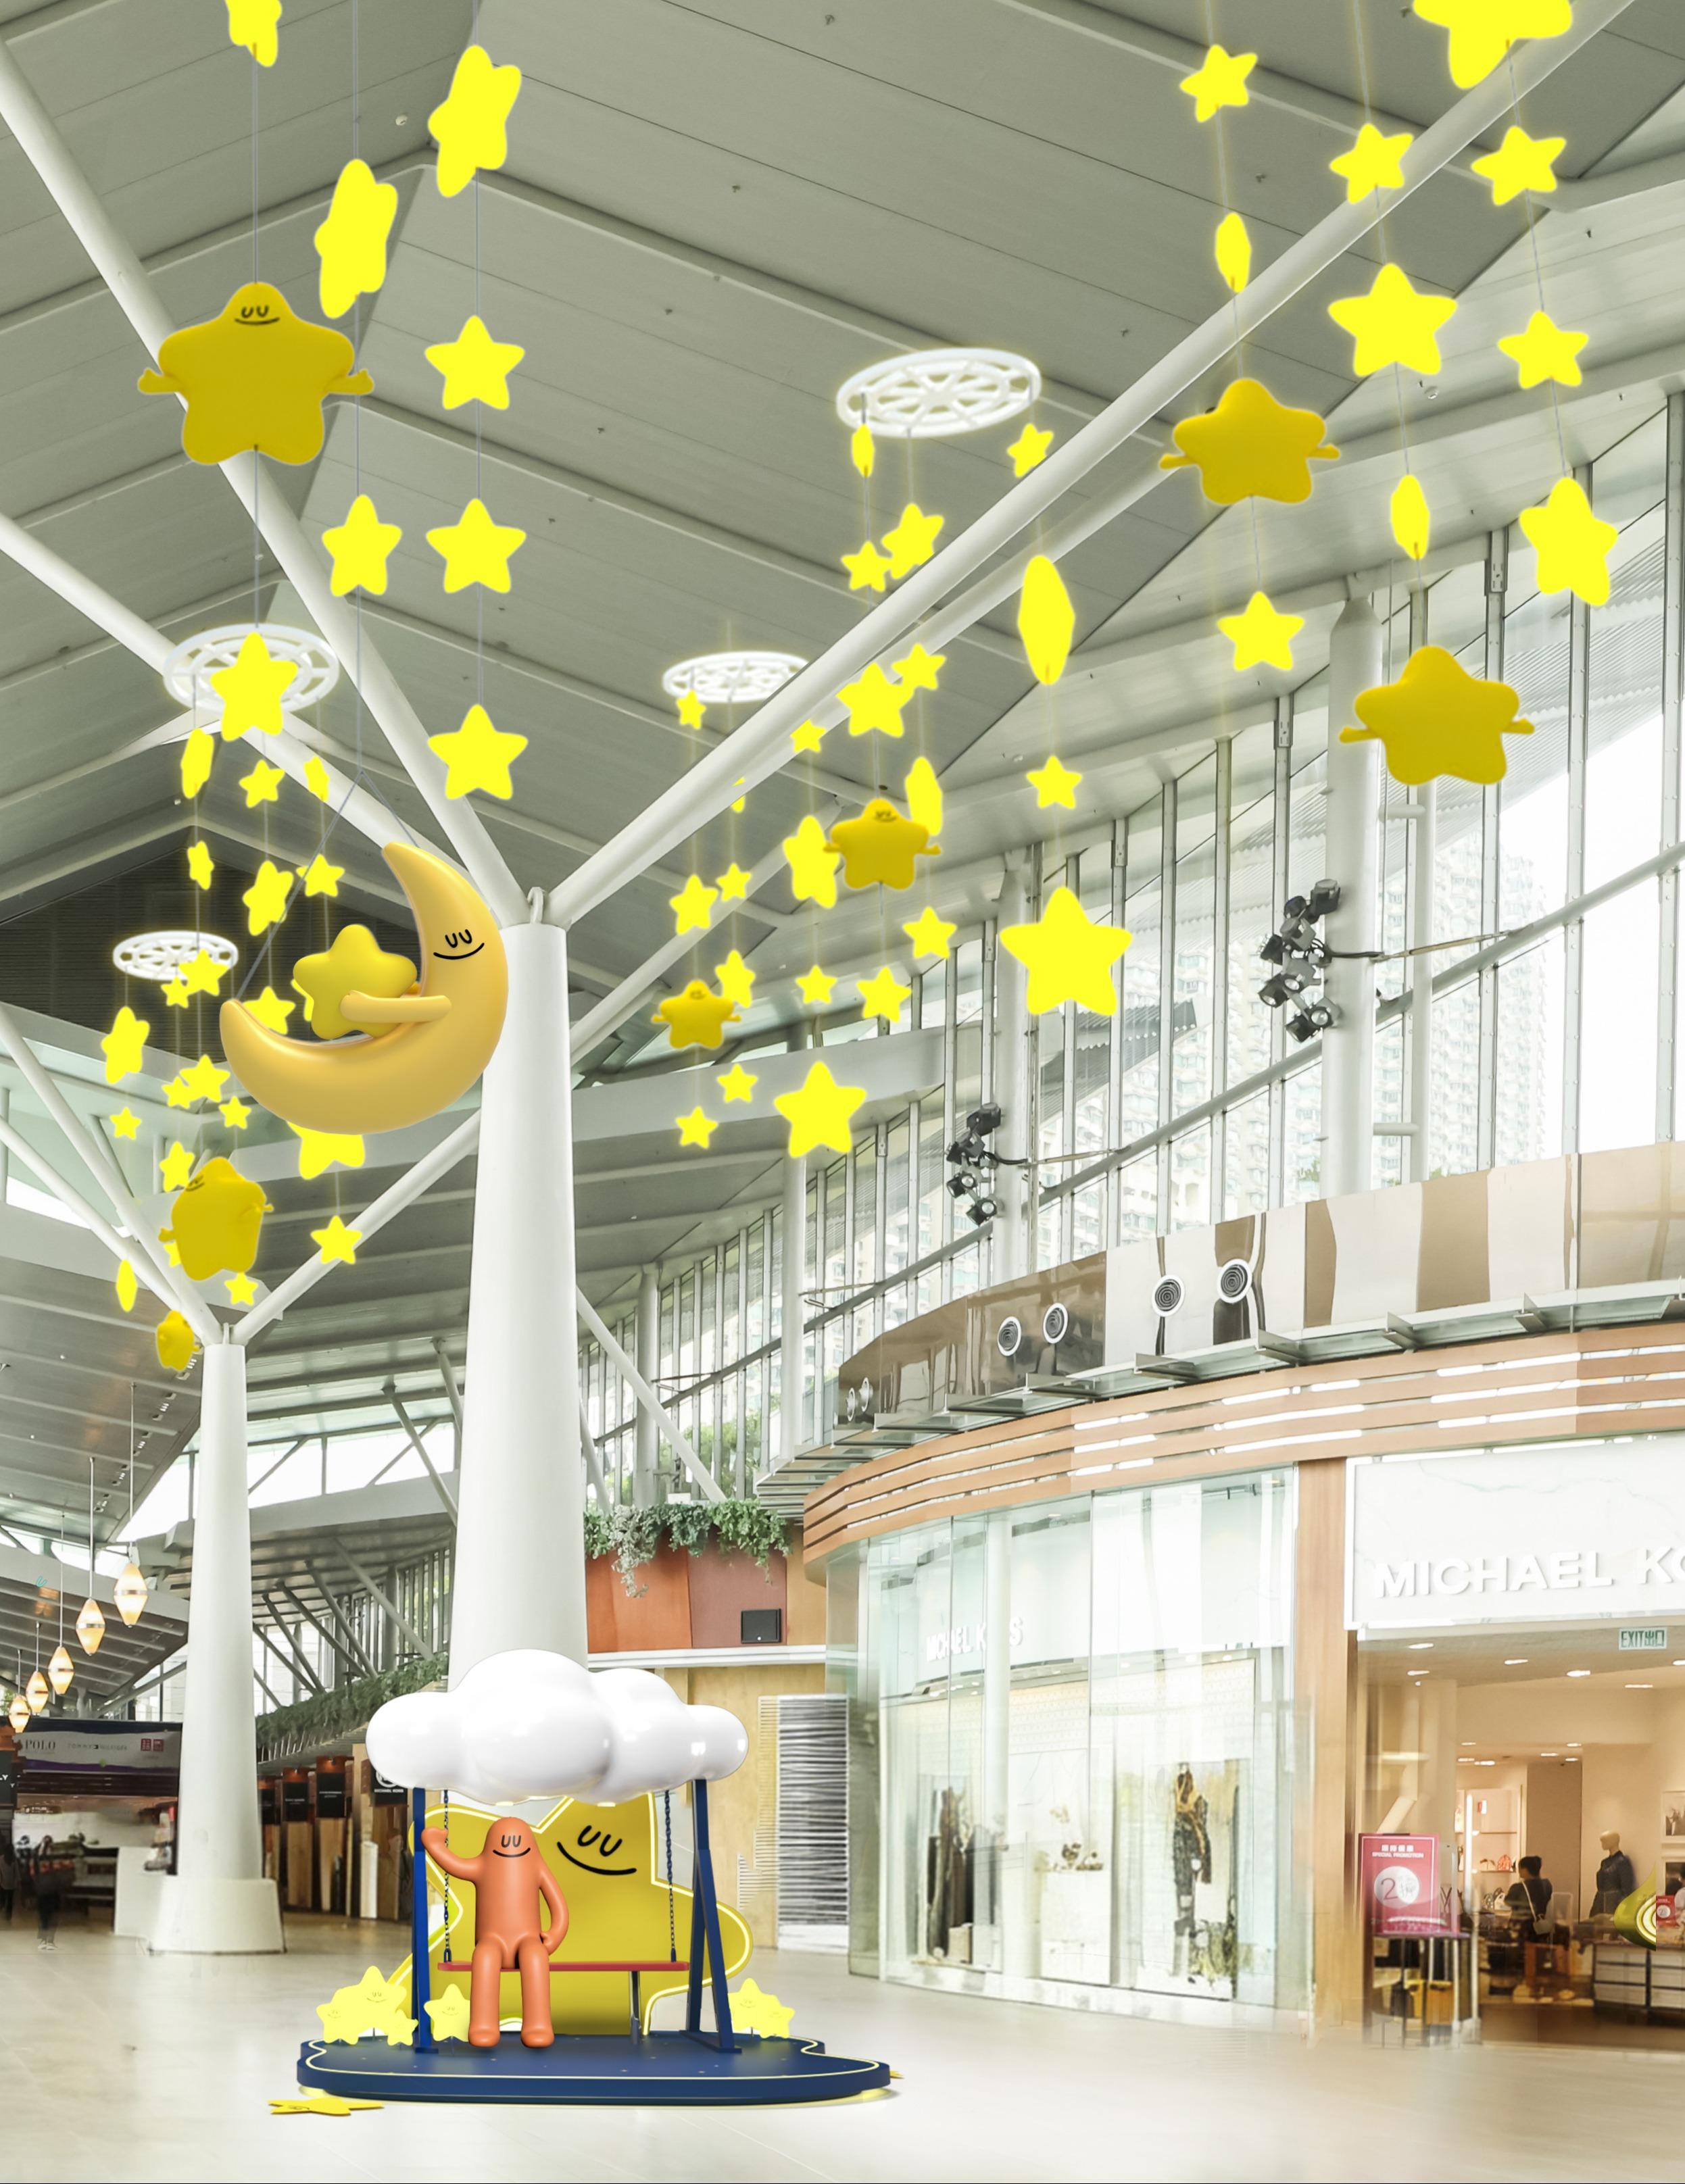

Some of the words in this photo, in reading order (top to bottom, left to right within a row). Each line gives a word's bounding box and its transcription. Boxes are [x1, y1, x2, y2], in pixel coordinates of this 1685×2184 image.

[1373, 1551, 1614, 1599] MICHAEL
[1621, 1630, 1644, 1647] EXIT
[1644, 1629, 1665, 1647] 出口
[25, 1739, 56, 1751] POLO
